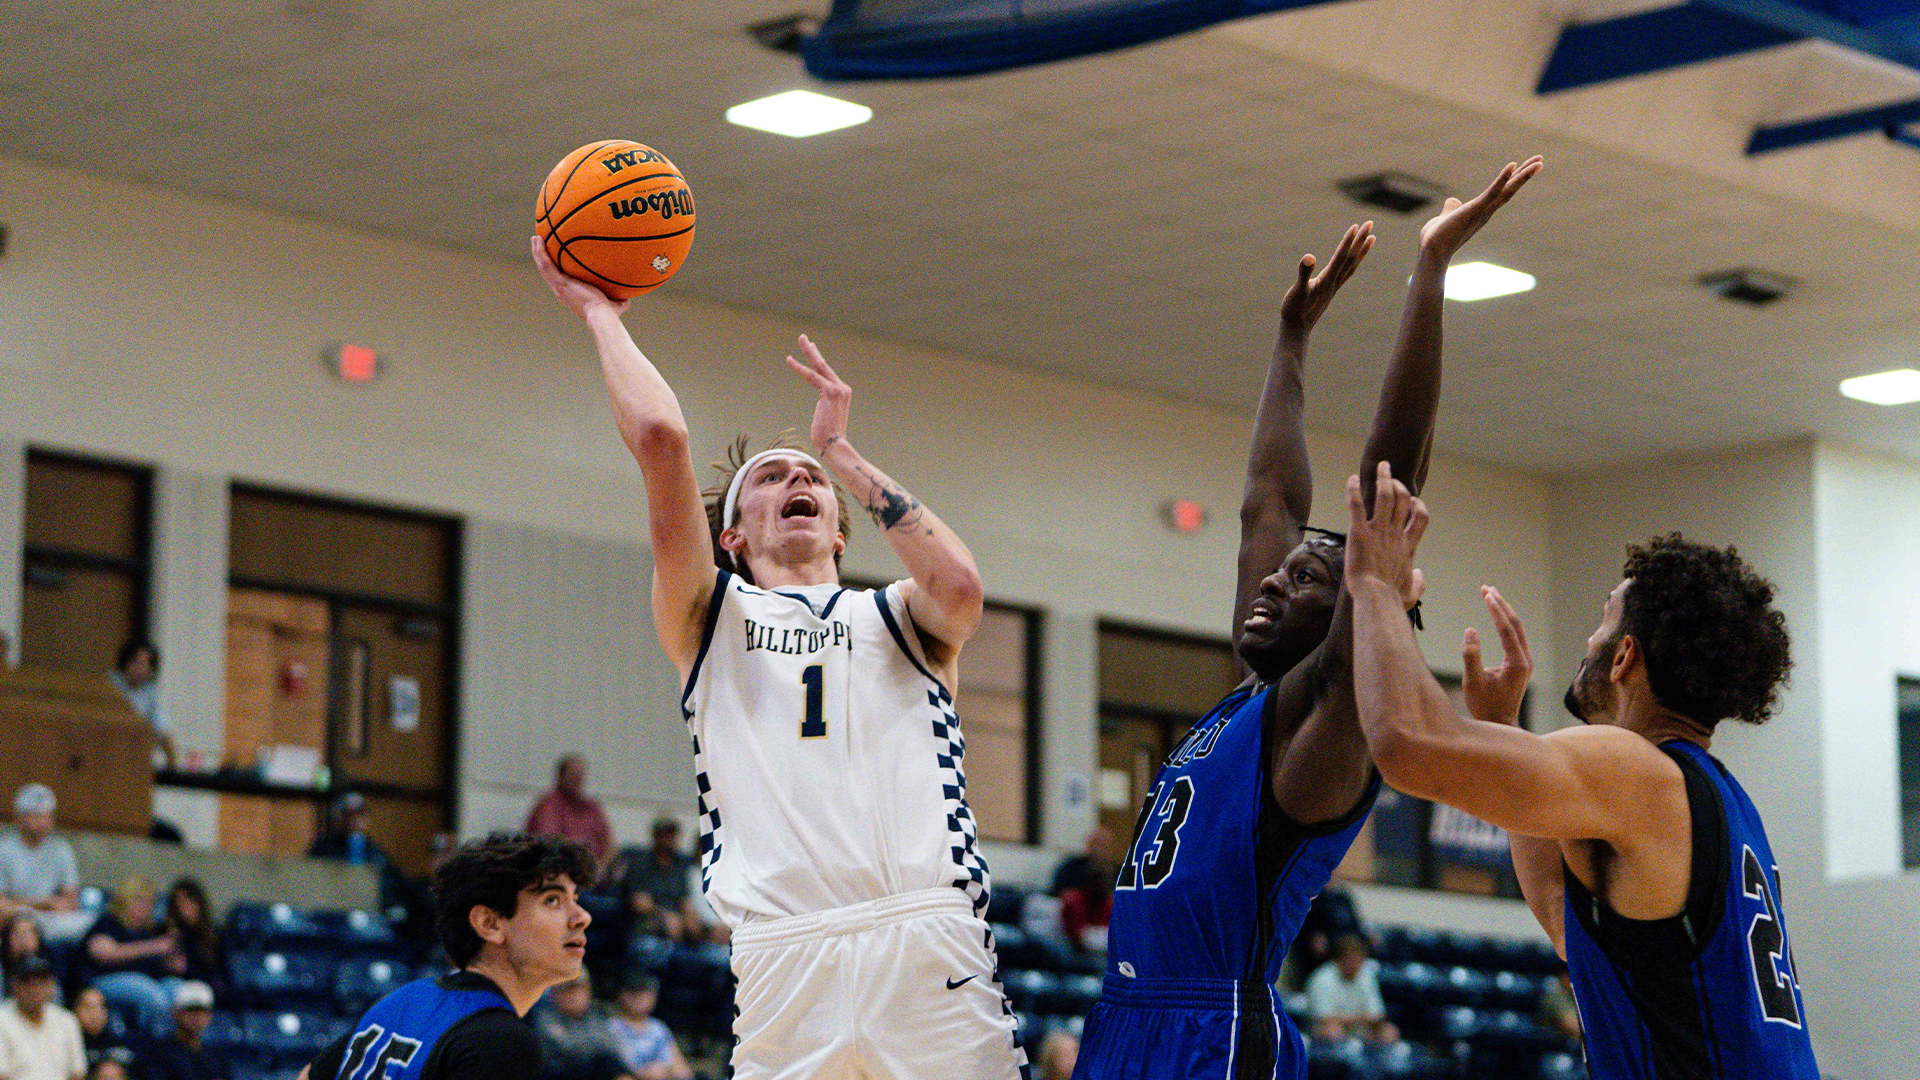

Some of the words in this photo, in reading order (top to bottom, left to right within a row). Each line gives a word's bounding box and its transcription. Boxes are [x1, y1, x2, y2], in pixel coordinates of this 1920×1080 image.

[601, 149, 668, 175] NCAA
[607, 188, 695, 220] Wilson
[799, 662, 829, 740] 1
[1115, 775, 1195, 891] 13
[1741, 843, 1802, 1030] 2
